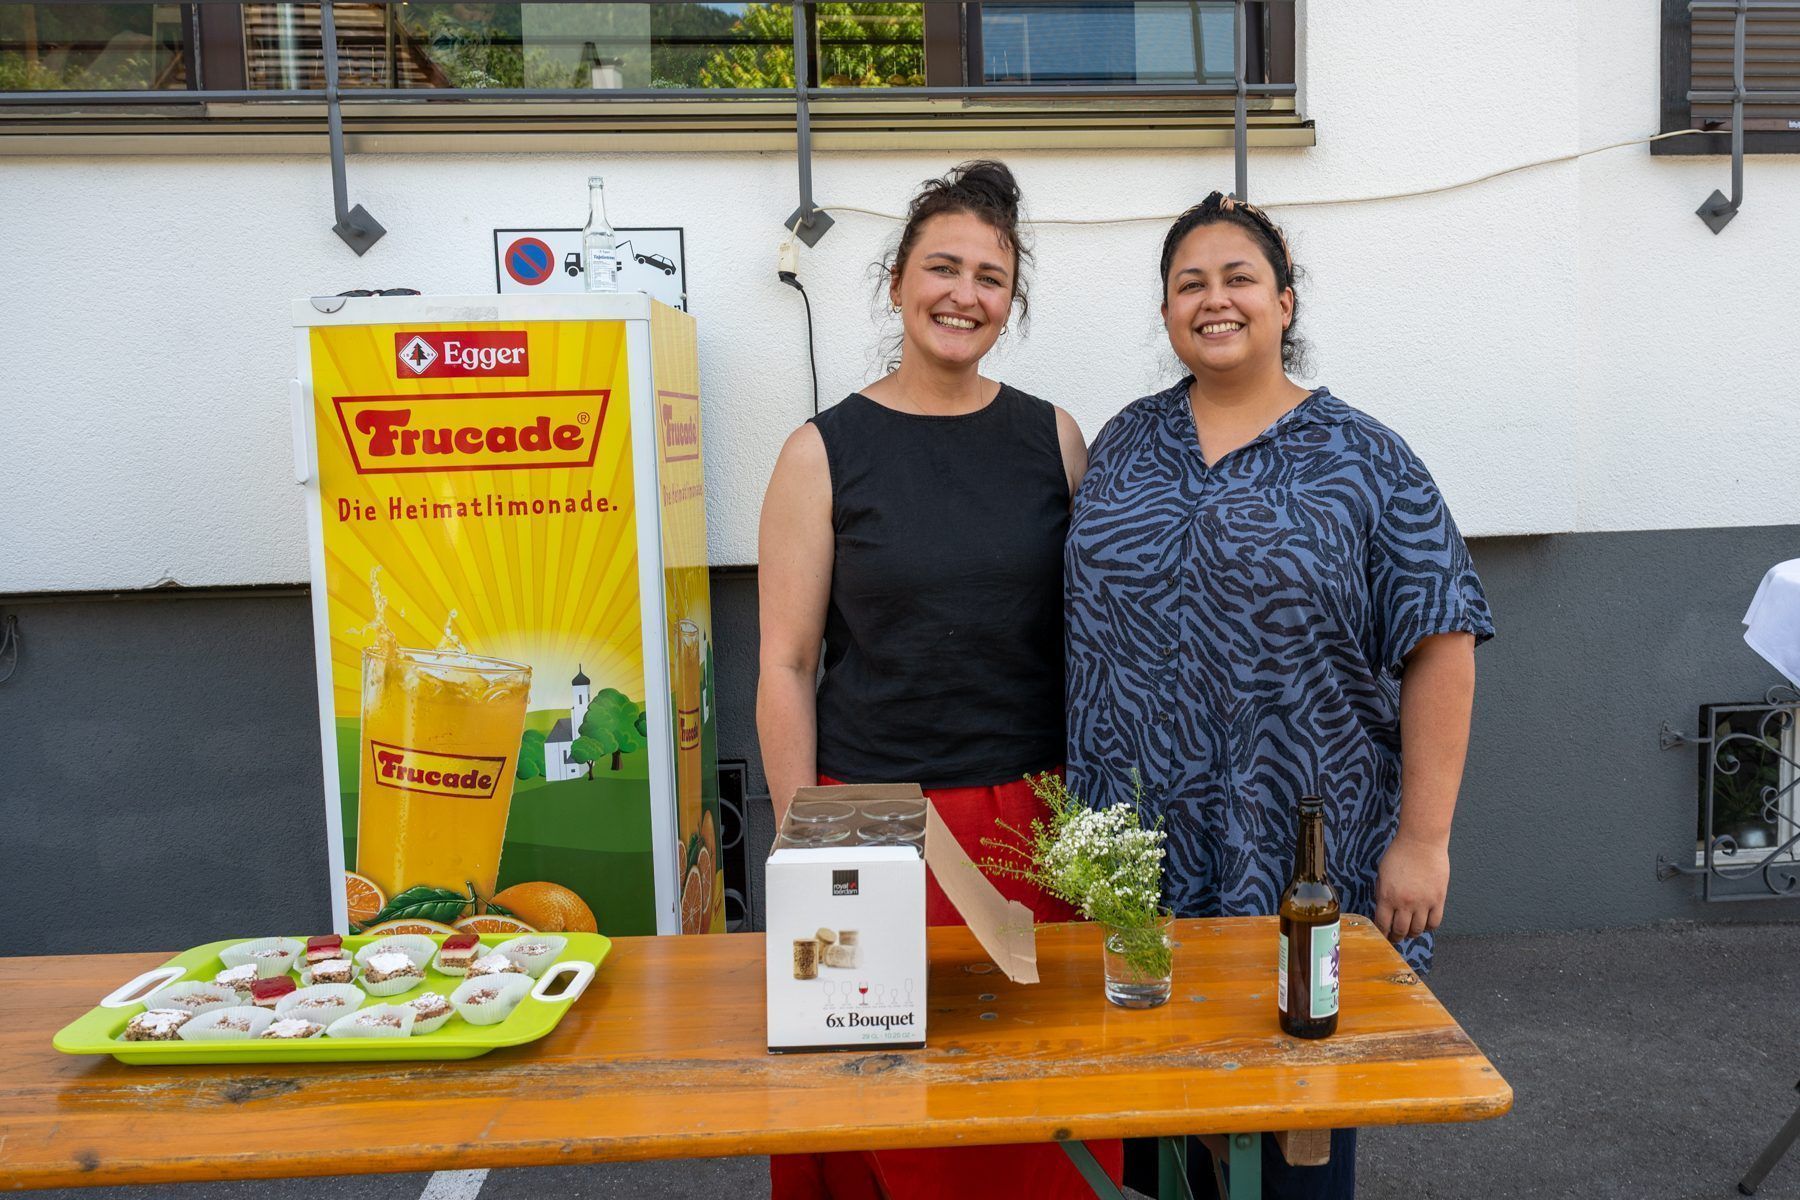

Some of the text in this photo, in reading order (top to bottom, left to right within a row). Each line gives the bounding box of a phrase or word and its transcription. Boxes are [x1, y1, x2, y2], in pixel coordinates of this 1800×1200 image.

[443, 341, 526, 370] Egger
[338, 489, 619, 522] Die Heimatlimonade.
[377, 750, 492, 790] Frucade
[826, 1011, 915, 1030] 6x Bouquet
